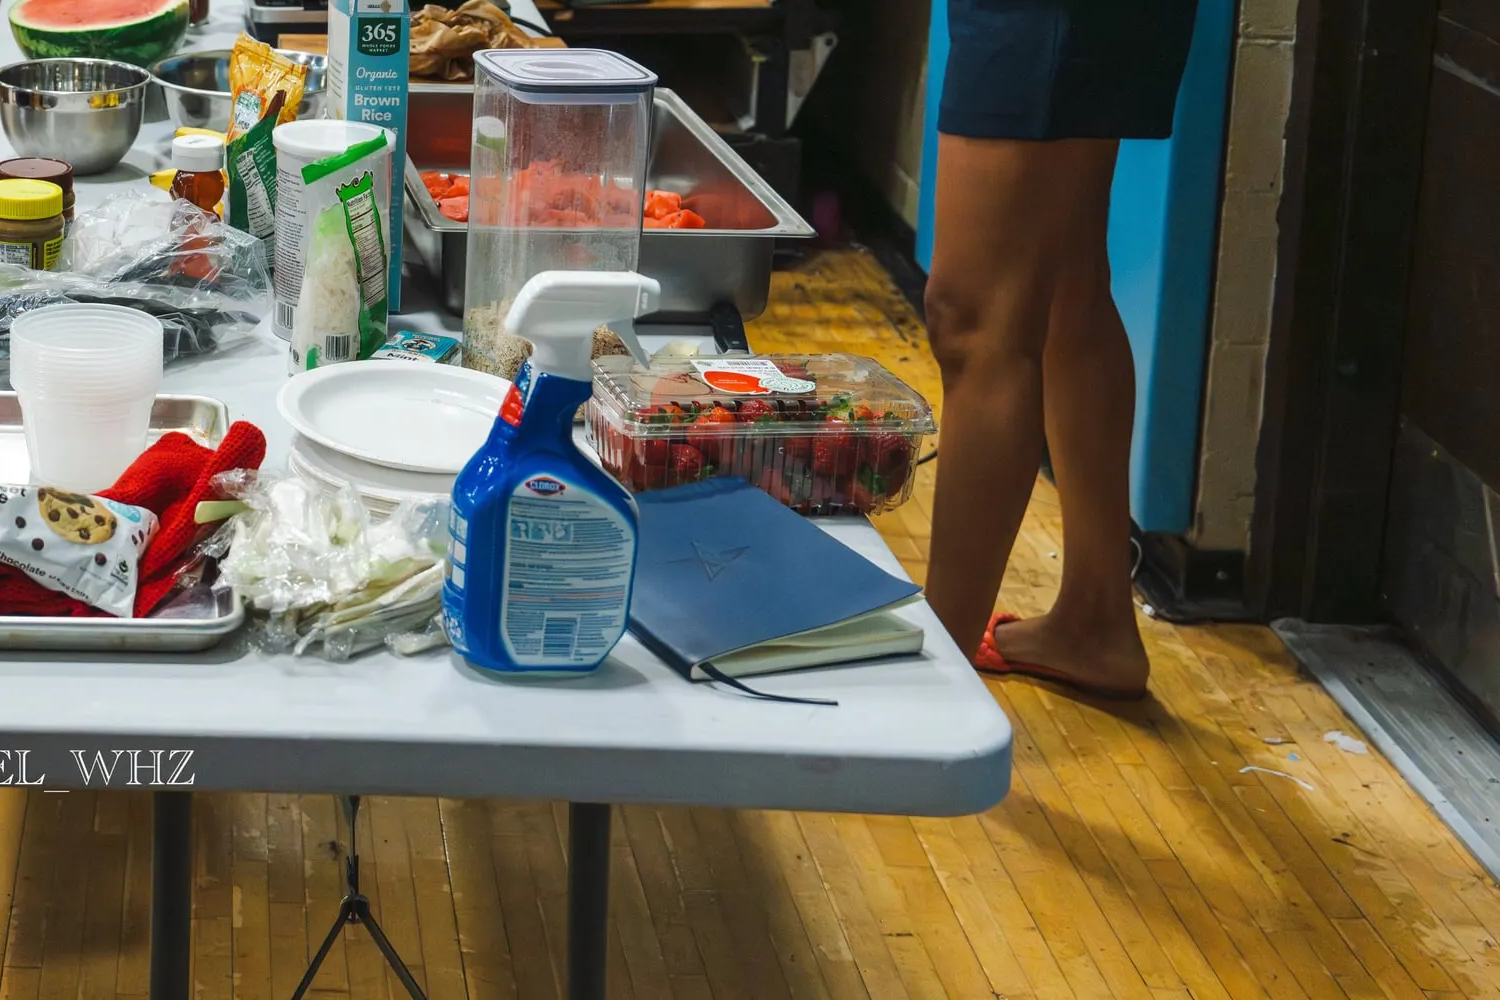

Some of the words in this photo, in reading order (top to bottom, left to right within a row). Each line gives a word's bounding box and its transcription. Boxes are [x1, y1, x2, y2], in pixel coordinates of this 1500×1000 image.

[361, 22, 397, 42] 365
[356, 66, 398, 82] Organic
[354, 93, 400, 106] Brown
[361, 108, 392, 121] Rice
[387, 352, 420, 361] Mint
[529, 480, 561, 490] CLOROX
